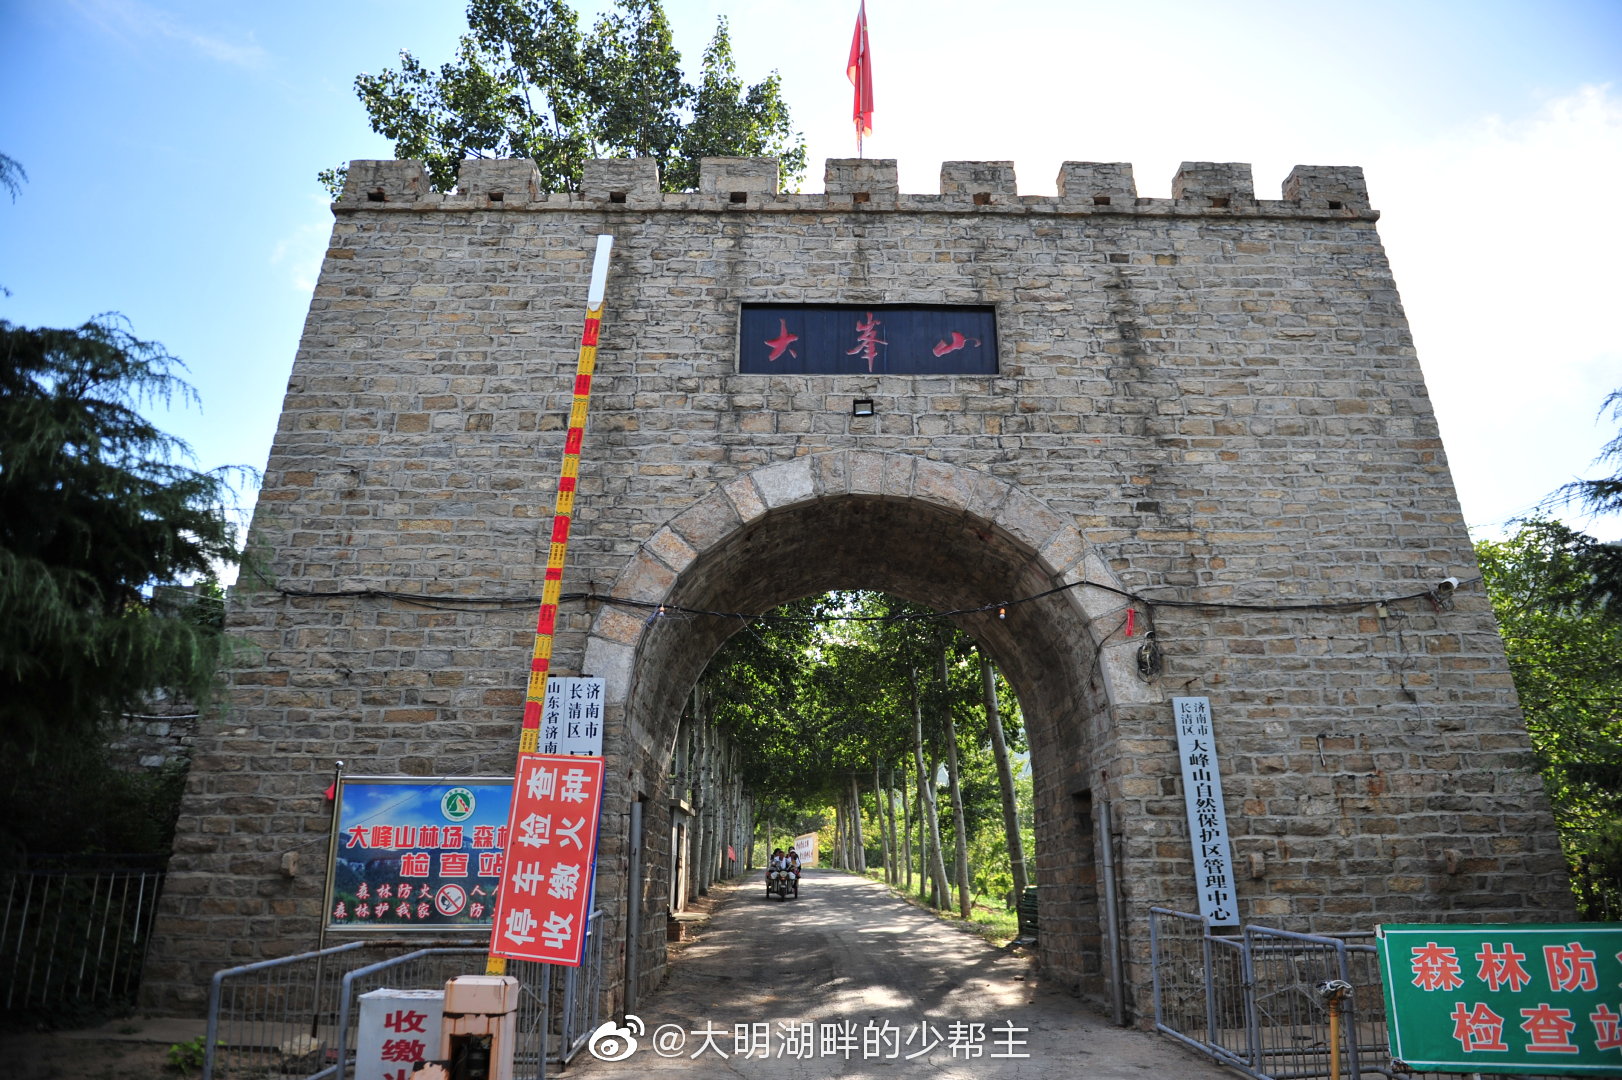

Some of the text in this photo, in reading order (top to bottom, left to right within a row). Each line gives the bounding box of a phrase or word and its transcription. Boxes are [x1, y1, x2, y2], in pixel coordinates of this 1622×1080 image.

[567, 683, 583, 739] 长清区
[585, 683, 600, 739] 济南市
[1180, 702, 1195, 737] 长清区
[1193, 702, 1208, 737] 济南市
[346, 824, 463, 850] 大峰山林场
[504, 766, 558, 946] 停车检查
[1188, 739, 1231, 922] 大峰山自然保护区管理中心
[541, 767, 592, 950] 收缴火种
[333, 901, 497, 920] 森林护我家 防
[356, 882, 434, 900] 森林防火
[1410, 941, 1622, 993] 森林防
